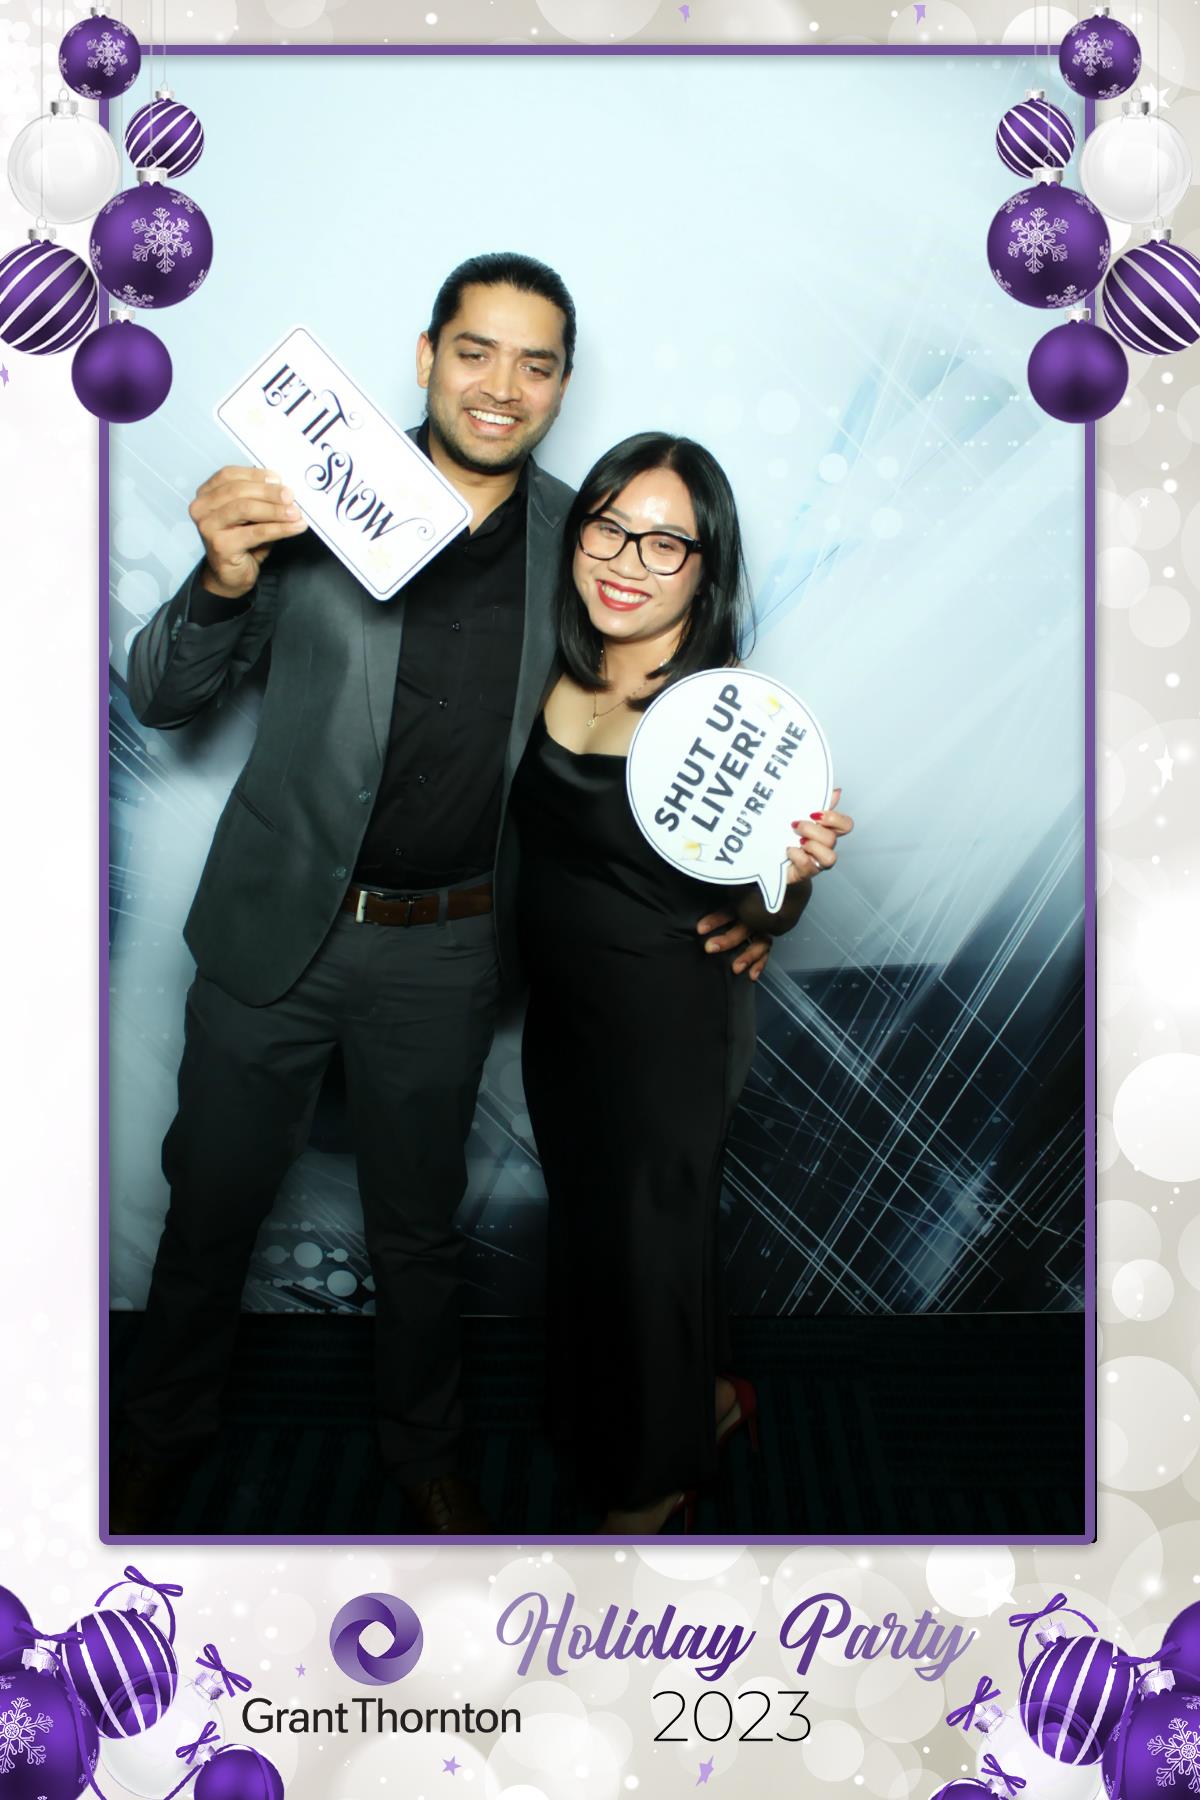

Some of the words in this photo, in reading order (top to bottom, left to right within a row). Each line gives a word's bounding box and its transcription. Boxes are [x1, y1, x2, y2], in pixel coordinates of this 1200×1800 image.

[262, 364, 316, 417] LET
[301, 388, 365, 445] IT
[304, 442, 436, 542] SNOW
[654, 737, 716, 832] SHUT
[705, 684, 742, 733] UP
[691, 719, 767, 833] LIVER!
[714, 781, 774, 865] YOU'RE
[763, 721, 807, 780] FINE
